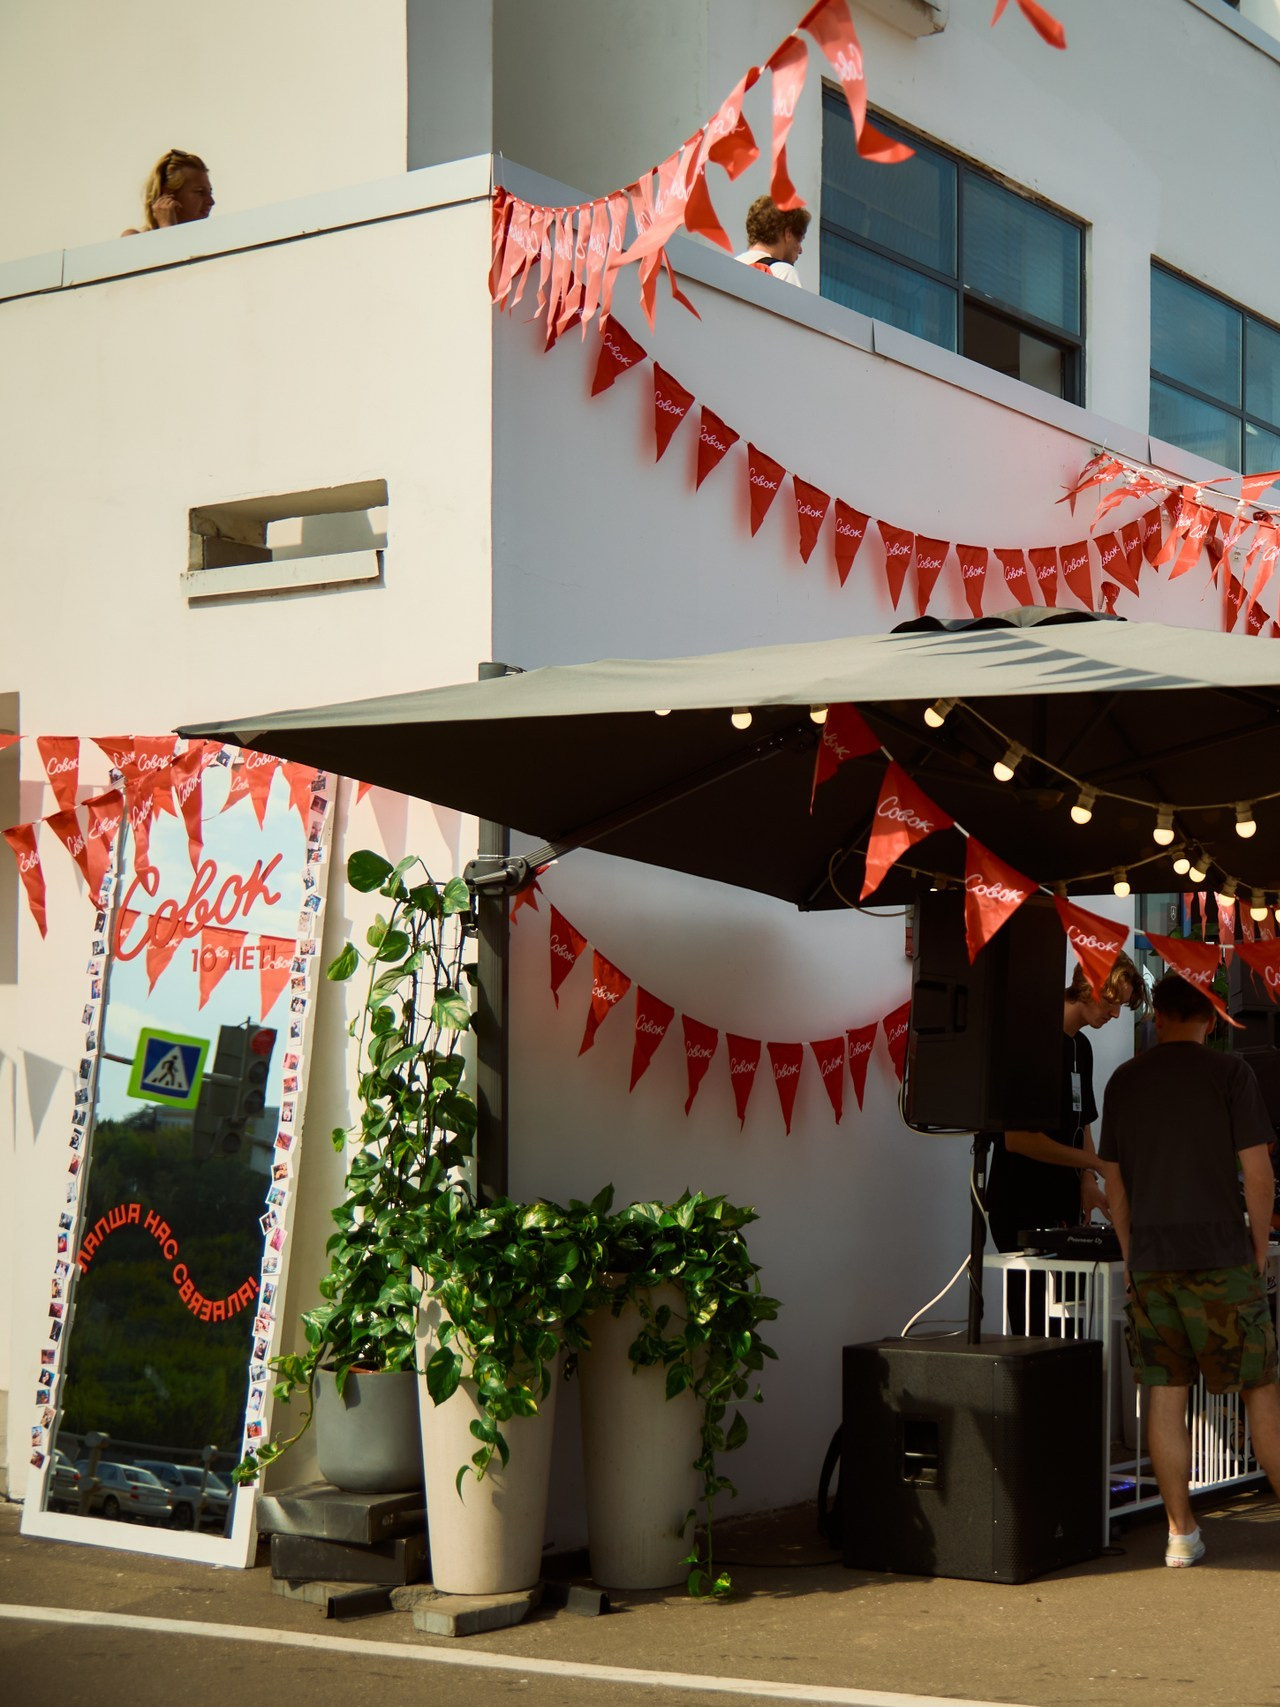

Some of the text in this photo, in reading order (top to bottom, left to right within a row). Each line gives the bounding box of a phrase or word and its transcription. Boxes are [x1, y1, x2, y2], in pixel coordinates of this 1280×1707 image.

[750, 467, 777, 490] Совок
[836, 518, 862, 538] Совок
[916, 554, 942, 569] Совок
[1063, 554, 1088, 576] Совок
[1004, 565, 1026, 581] Совок
[246, 751, 278, 769] Сово
[877, 796, 934, 833] Совок
[965, 873, 1023, 903] Совок
[113, 852, 284, 962] Совок
[550, 934, 575, 963] Совок
[1067, 925, 1119, 954] Совок
[192, 944, 277, 973] 10 ЛЕТ!
[636, 1014, 665, 1036] Совок
[685, 1041, 712, 1059] Совок
[848, 1040, 872, 1060] Совок
[730, 1057, 757, 1074] Совок
[774, 1063, 799, 1081] Совок
[76, 1203, 261, 1323] ЛАПША НАС СВЯЗАЛА!
